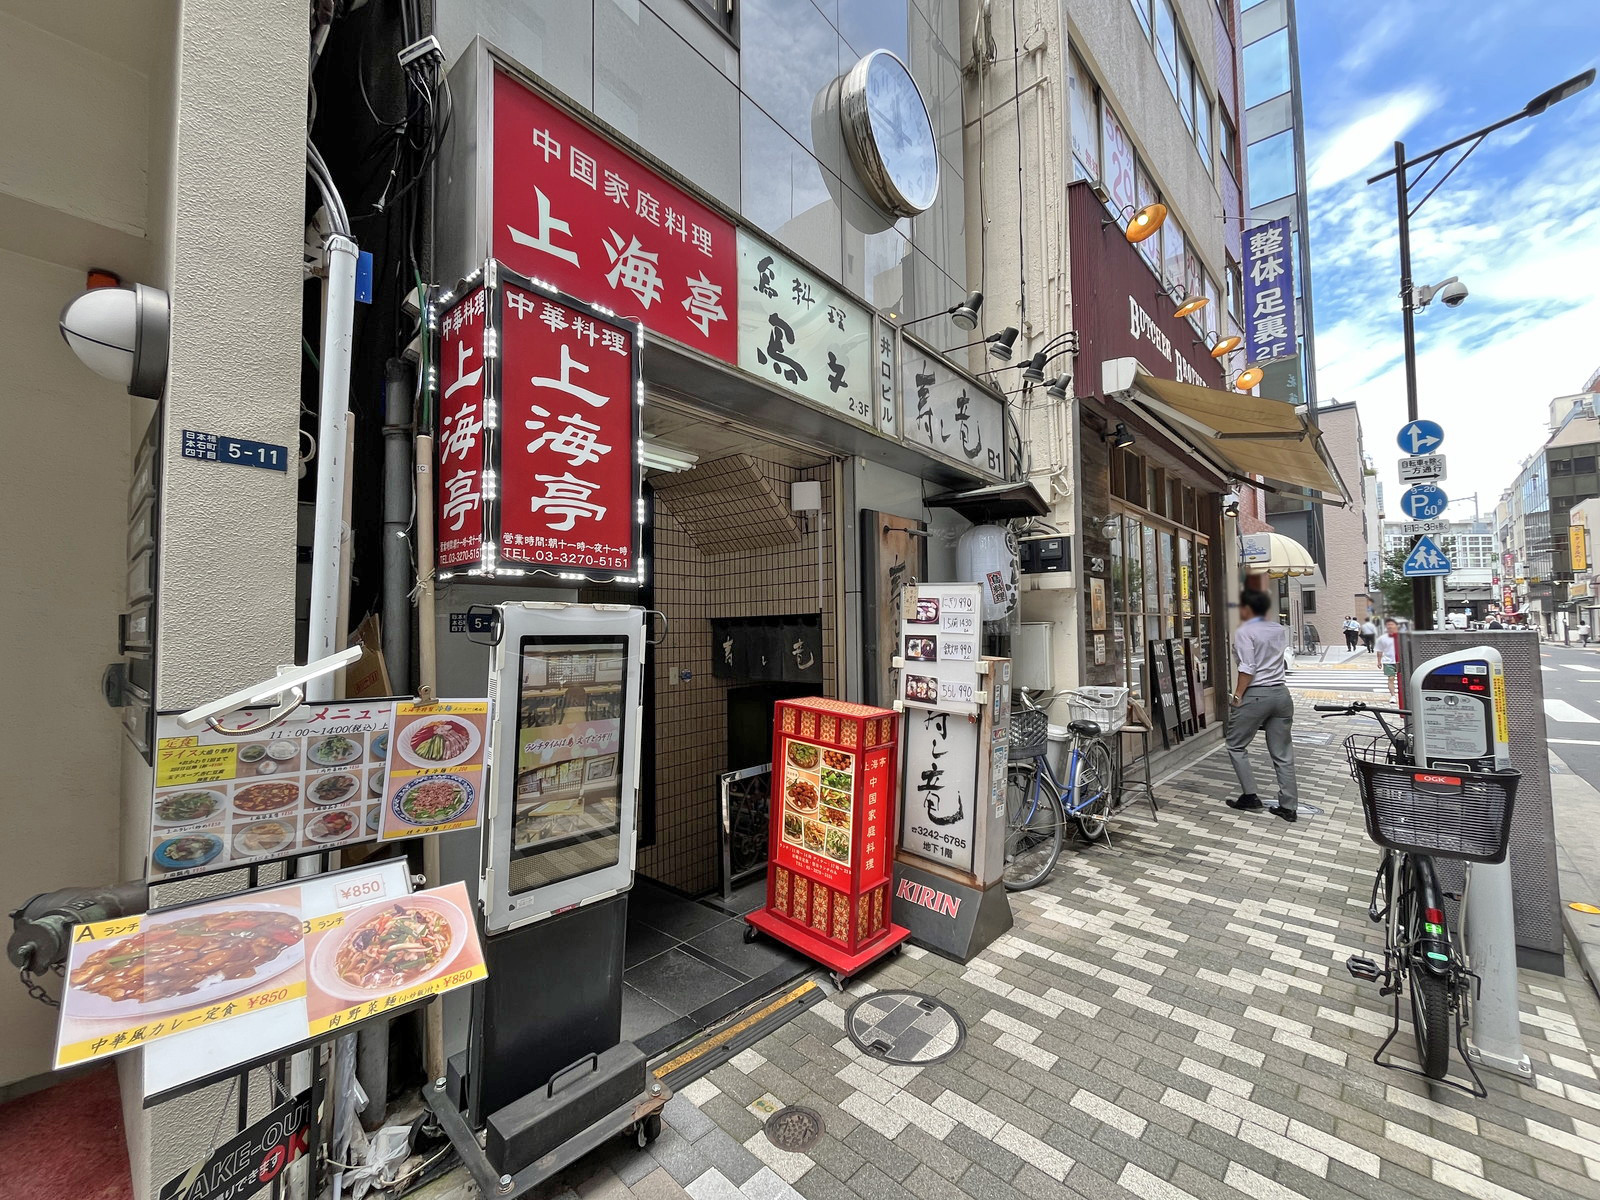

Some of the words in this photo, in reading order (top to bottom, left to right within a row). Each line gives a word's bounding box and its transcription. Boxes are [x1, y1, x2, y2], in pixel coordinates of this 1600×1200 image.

[533, 127, 713, 258] 中国家庭料理
[506, 184, 728, 338] 上海亭
[506, 290, 628, 356] 中華料理
[1129, 295, 1172, 363] BUTCHER
[1256, 342, 1285, 362] 2F
[880, 335, 893, 423] 井口ビル
[186, 440, 217, 451] 本石町
[441, 340, 483, 531] 上海亭
[524, 343, 613, 532] 上海亭
[185, 449, 217, 460] 四丁目
[228, 443, 278, 465] 5-11
[987, 448, 1001, 474] B1
[1401, 458, 1442, 468] 自転車を除く
[1402, 465, 1442, 475] 一方通行
[1410, 486, 1437, 494] 9-20
[1411, 494, 1429, 517] P
[503, 547, 629, 568] TEL.03-3270-5151
[1091, 557, 1105, 573] 29
[959, 597, 972, 609] 990
[960, 643, 972, 656] 990
[1154, 643, 1166, 655] NICE
[959, 683, 972, 698] 990
[864, 756, 887, 771] 上海亭
[1423, 775, 1446, 783] OGK
[865, 776, 878, 872] 中国家庭料理
[917, 826, 967, 849] 3242-6785
[922, 840, 953, 860] 地下1階
[340, 879, 381, 900] ¥850
[896, 878, 962, 918] KIRIN
[75, 925, 96, 942] A
[104, 922, 139, 937] ランチ
[317, 916, 344, 930] ランチ
[328, 994, 397, 1028] 肉野菜麺
[442, 969, 473, 988] ¥850
[91, 1001, 237, 1055] 中華風カレー定食
[248, 989, 288, 1009] ¥850
